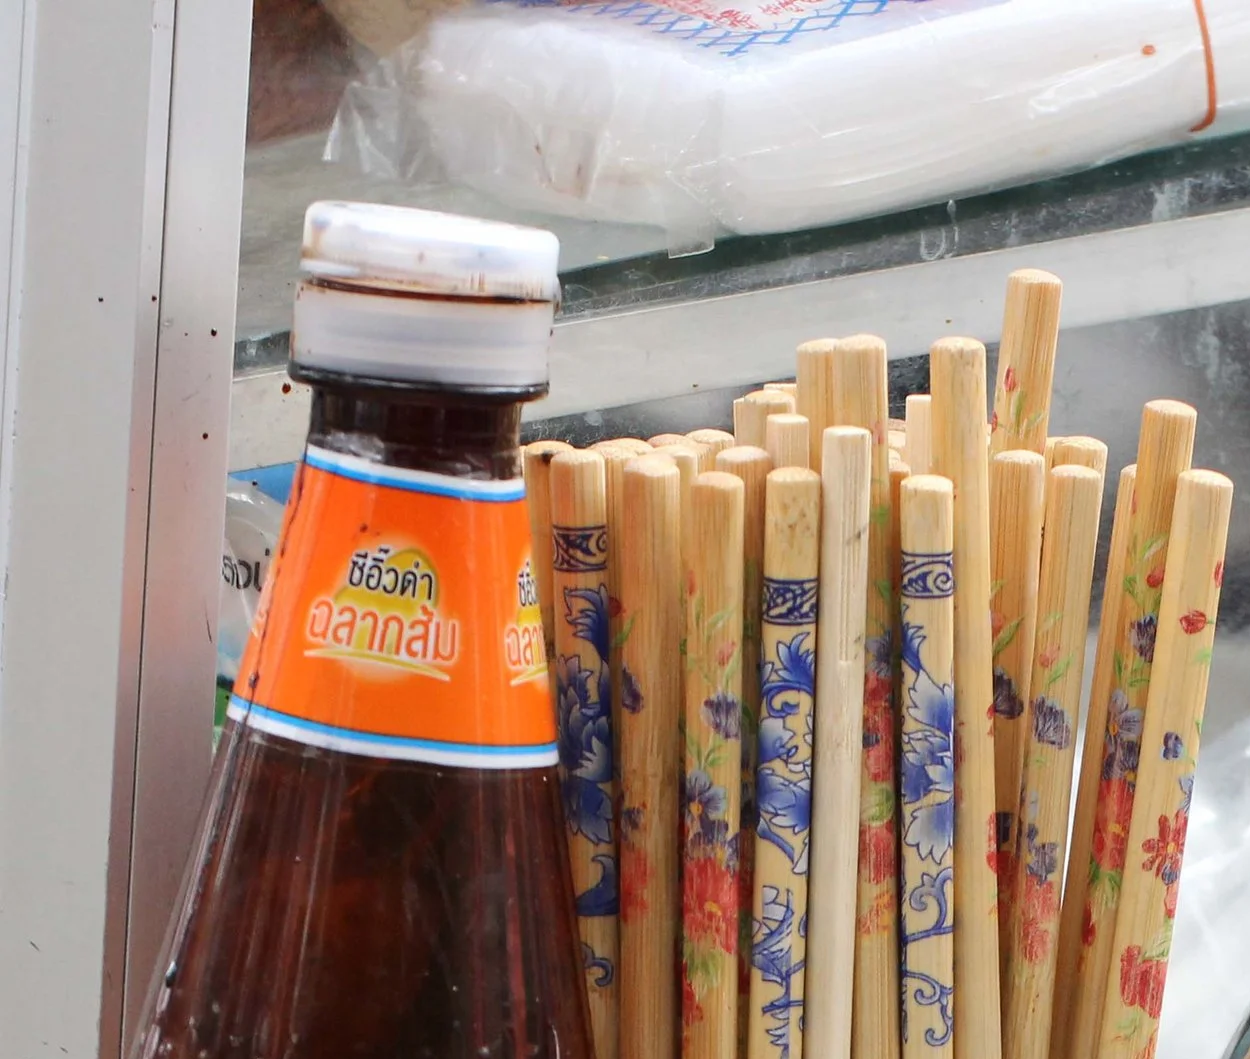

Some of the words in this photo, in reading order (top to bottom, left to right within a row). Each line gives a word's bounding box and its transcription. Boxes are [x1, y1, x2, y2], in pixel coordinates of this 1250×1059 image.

[348, 547, 433, 601] ซีอิ๊วดำ
[309, 599, 457, 663] ฉลากส้ม
